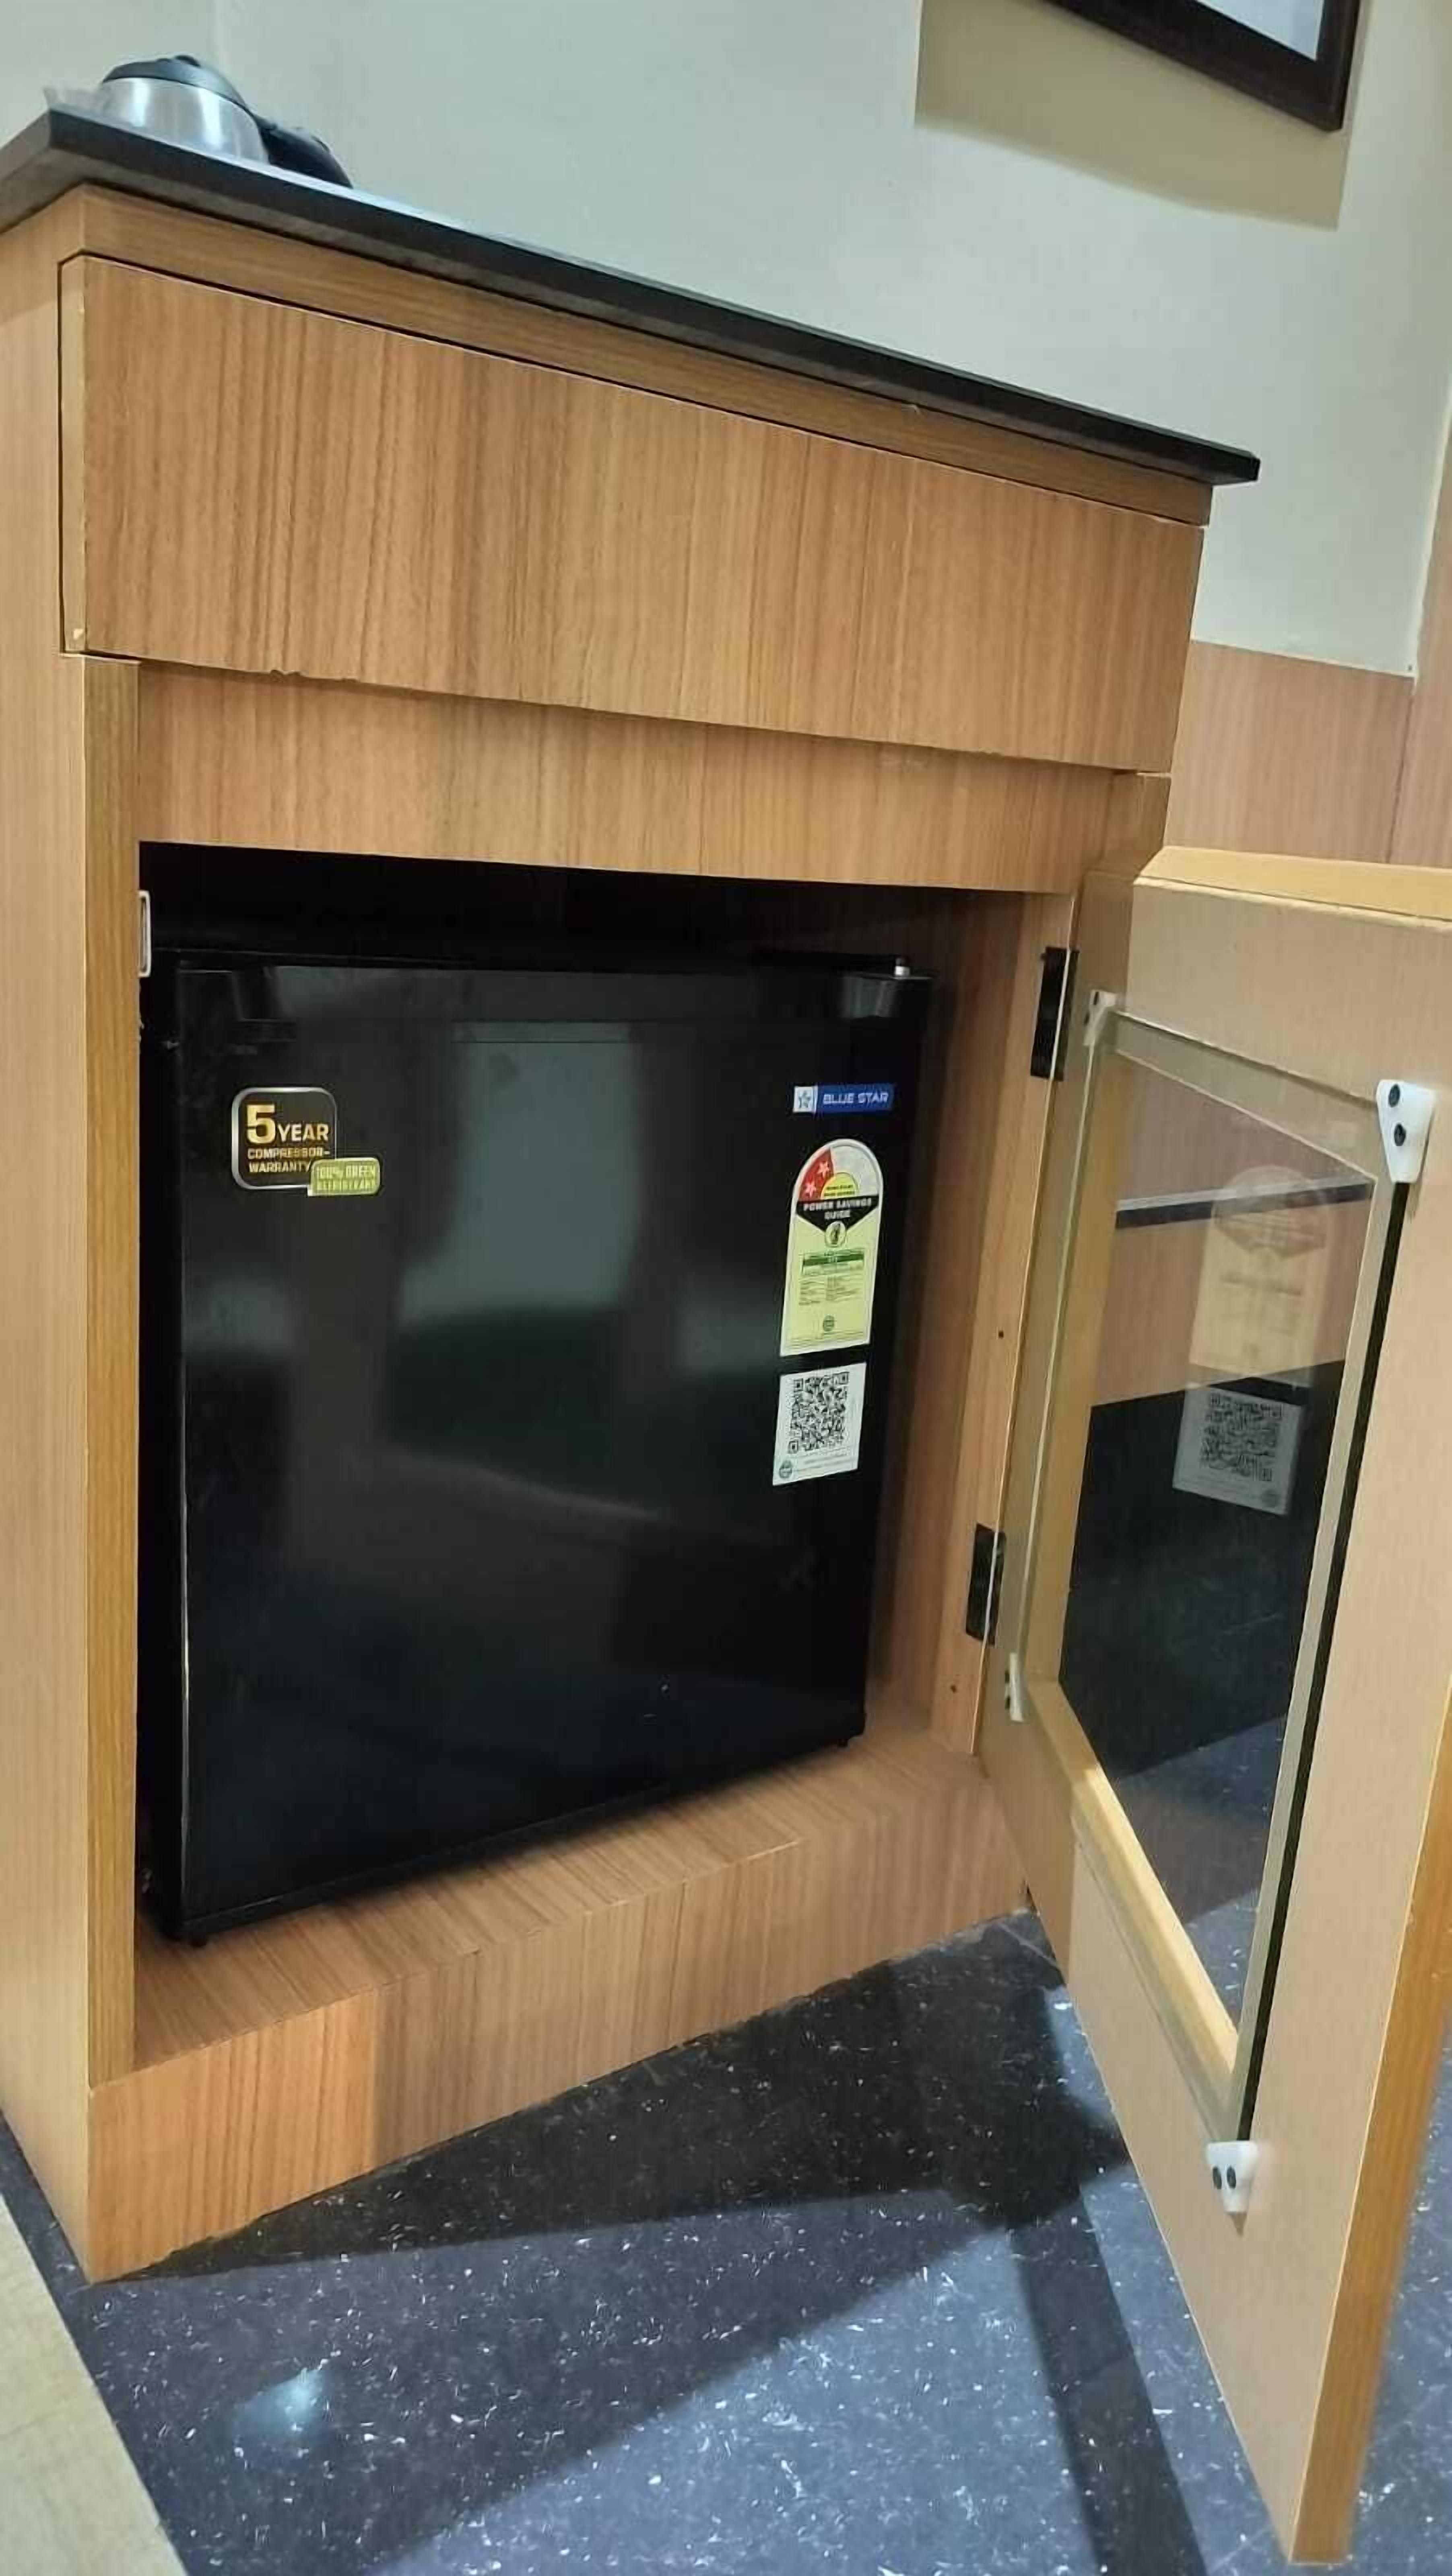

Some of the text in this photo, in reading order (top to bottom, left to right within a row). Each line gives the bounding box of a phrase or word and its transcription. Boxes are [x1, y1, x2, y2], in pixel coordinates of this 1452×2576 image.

[823, 1092, 889, 1104] BLUE STAR
[247, 1104, 329, 1144] 5 YEAR
[249, 1160, 311, 1172] WARRANTY
